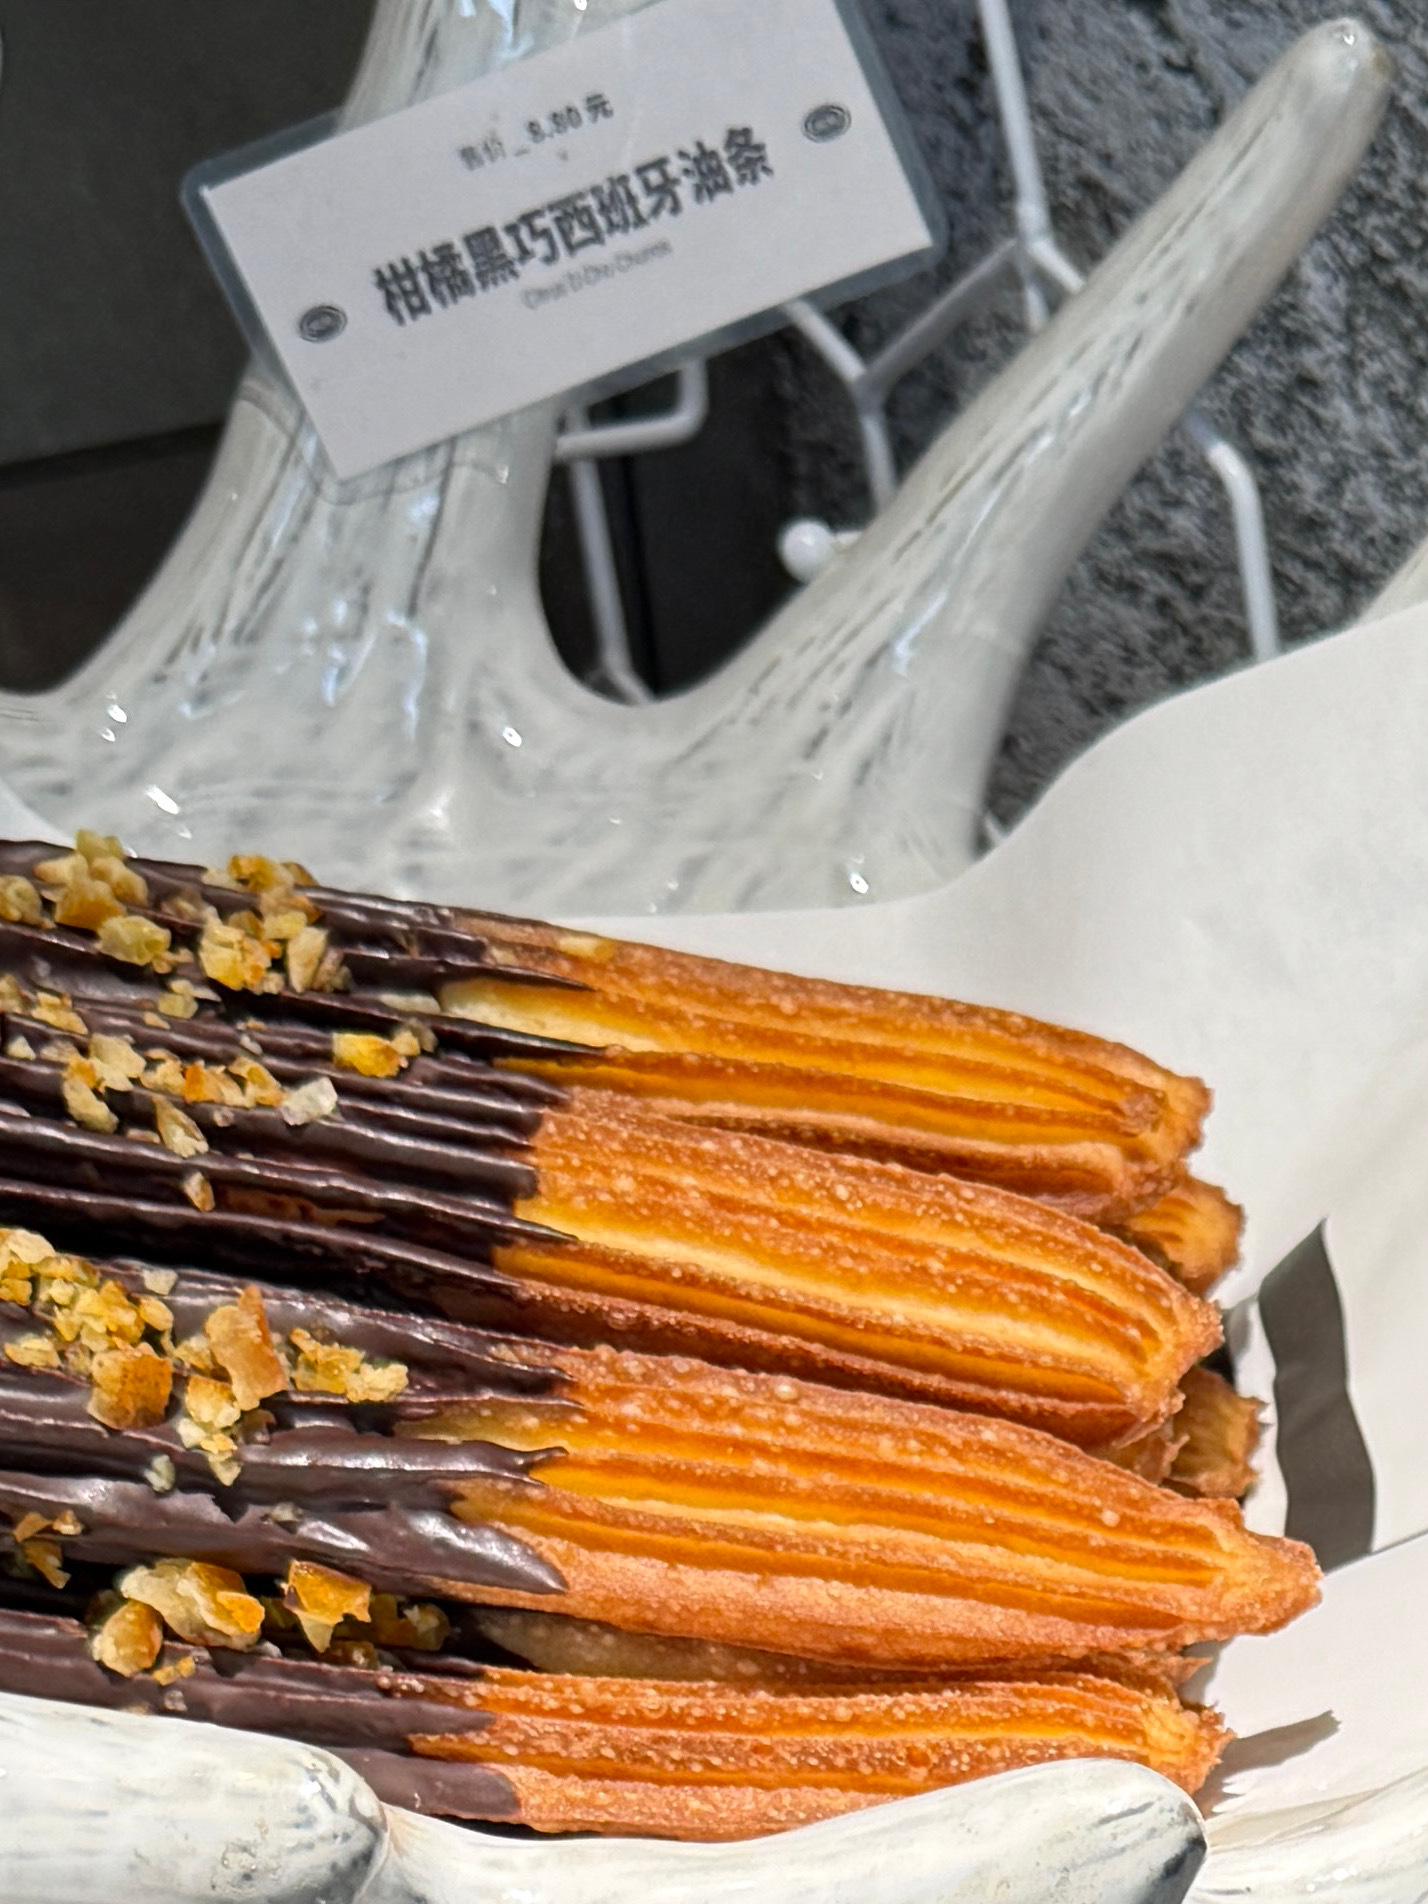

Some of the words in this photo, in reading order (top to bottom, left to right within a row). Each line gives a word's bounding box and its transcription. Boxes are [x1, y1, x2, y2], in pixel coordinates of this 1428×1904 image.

[373, 126, 775, 327] 柑橘黑巧西班牙油条
